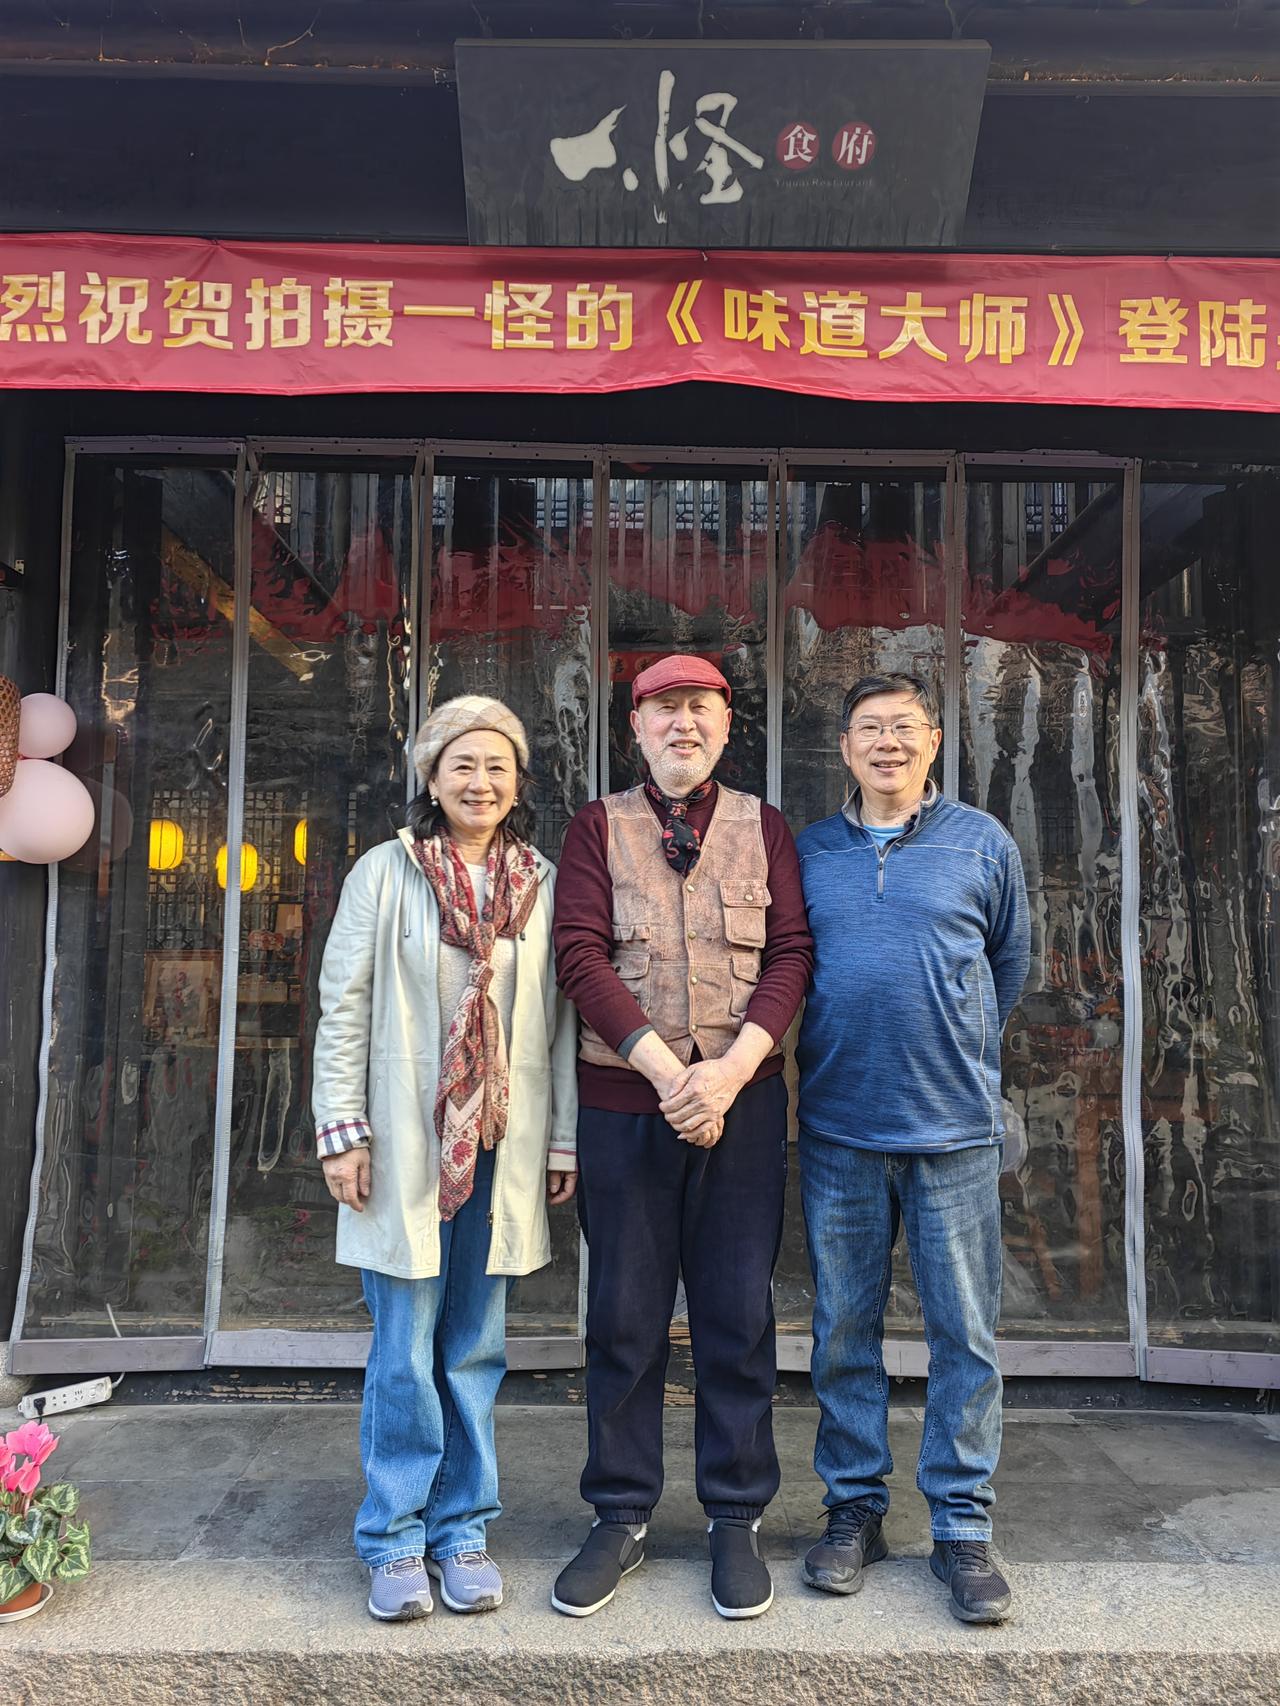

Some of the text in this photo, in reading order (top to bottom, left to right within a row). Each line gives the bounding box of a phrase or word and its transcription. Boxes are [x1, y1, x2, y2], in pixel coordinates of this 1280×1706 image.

[783, 124, 875, 165] 食府
[0, 270, 1280, 370] 烈祝贺拍摄一怪的《味道大师》登陆
